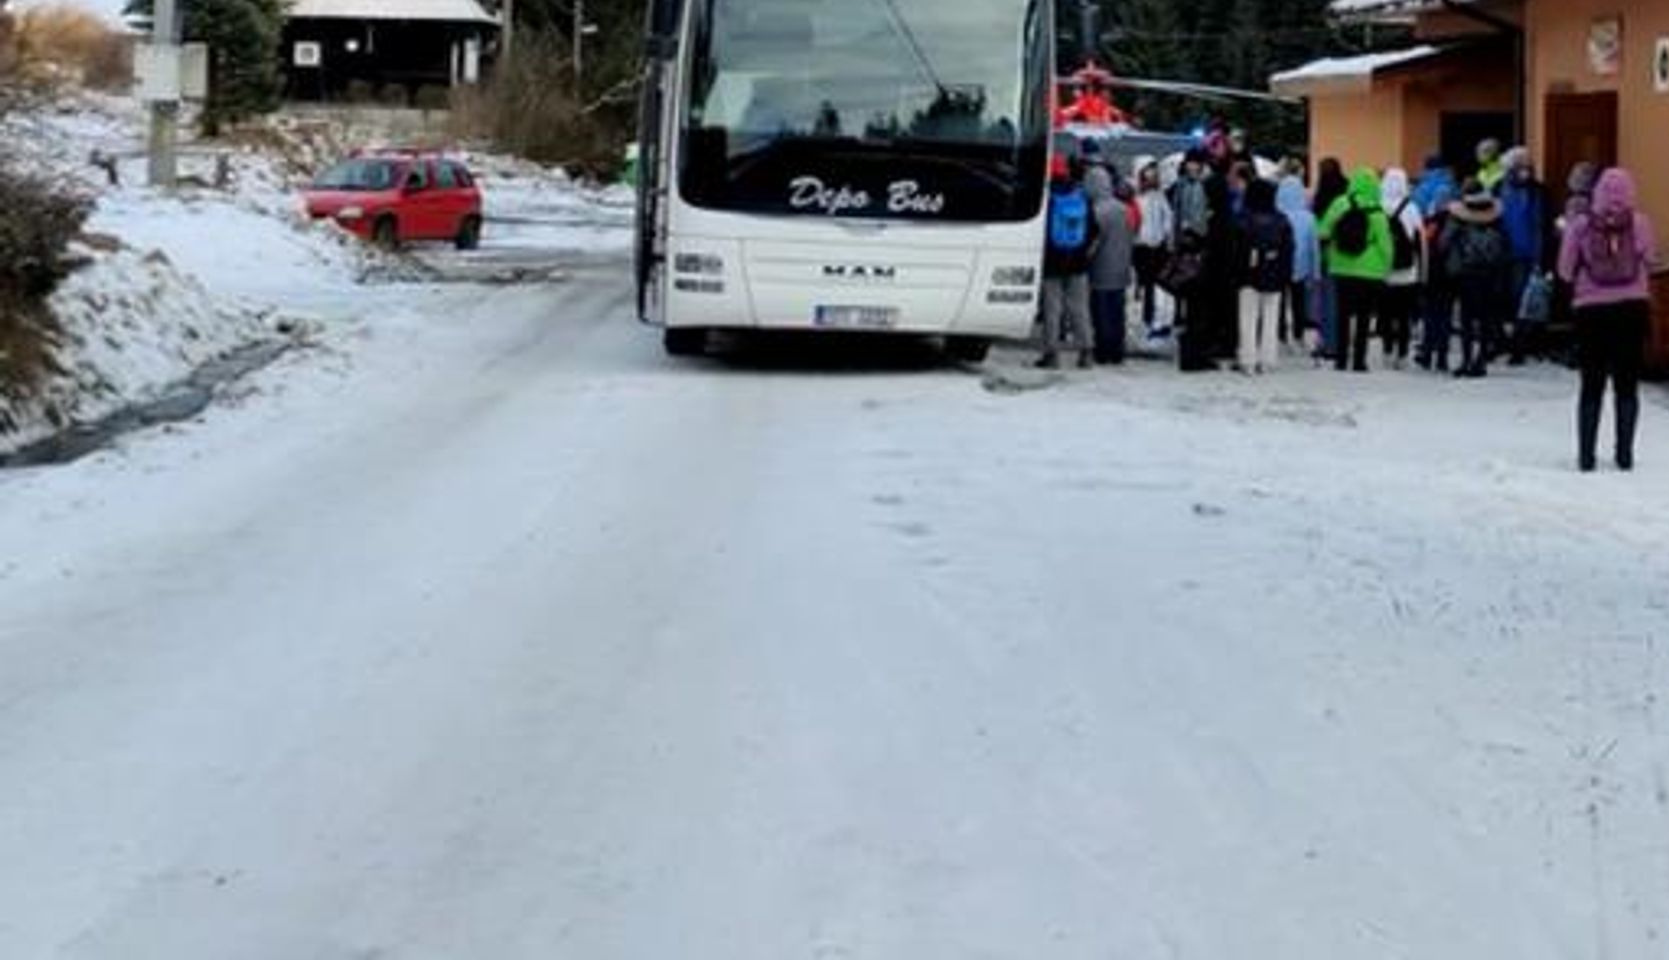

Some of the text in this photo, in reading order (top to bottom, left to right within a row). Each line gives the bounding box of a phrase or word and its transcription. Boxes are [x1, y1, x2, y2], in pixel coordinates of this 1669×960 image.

[789, 175, 944, 214] Depo Bus
[822, 265, 895, 278] MAN
